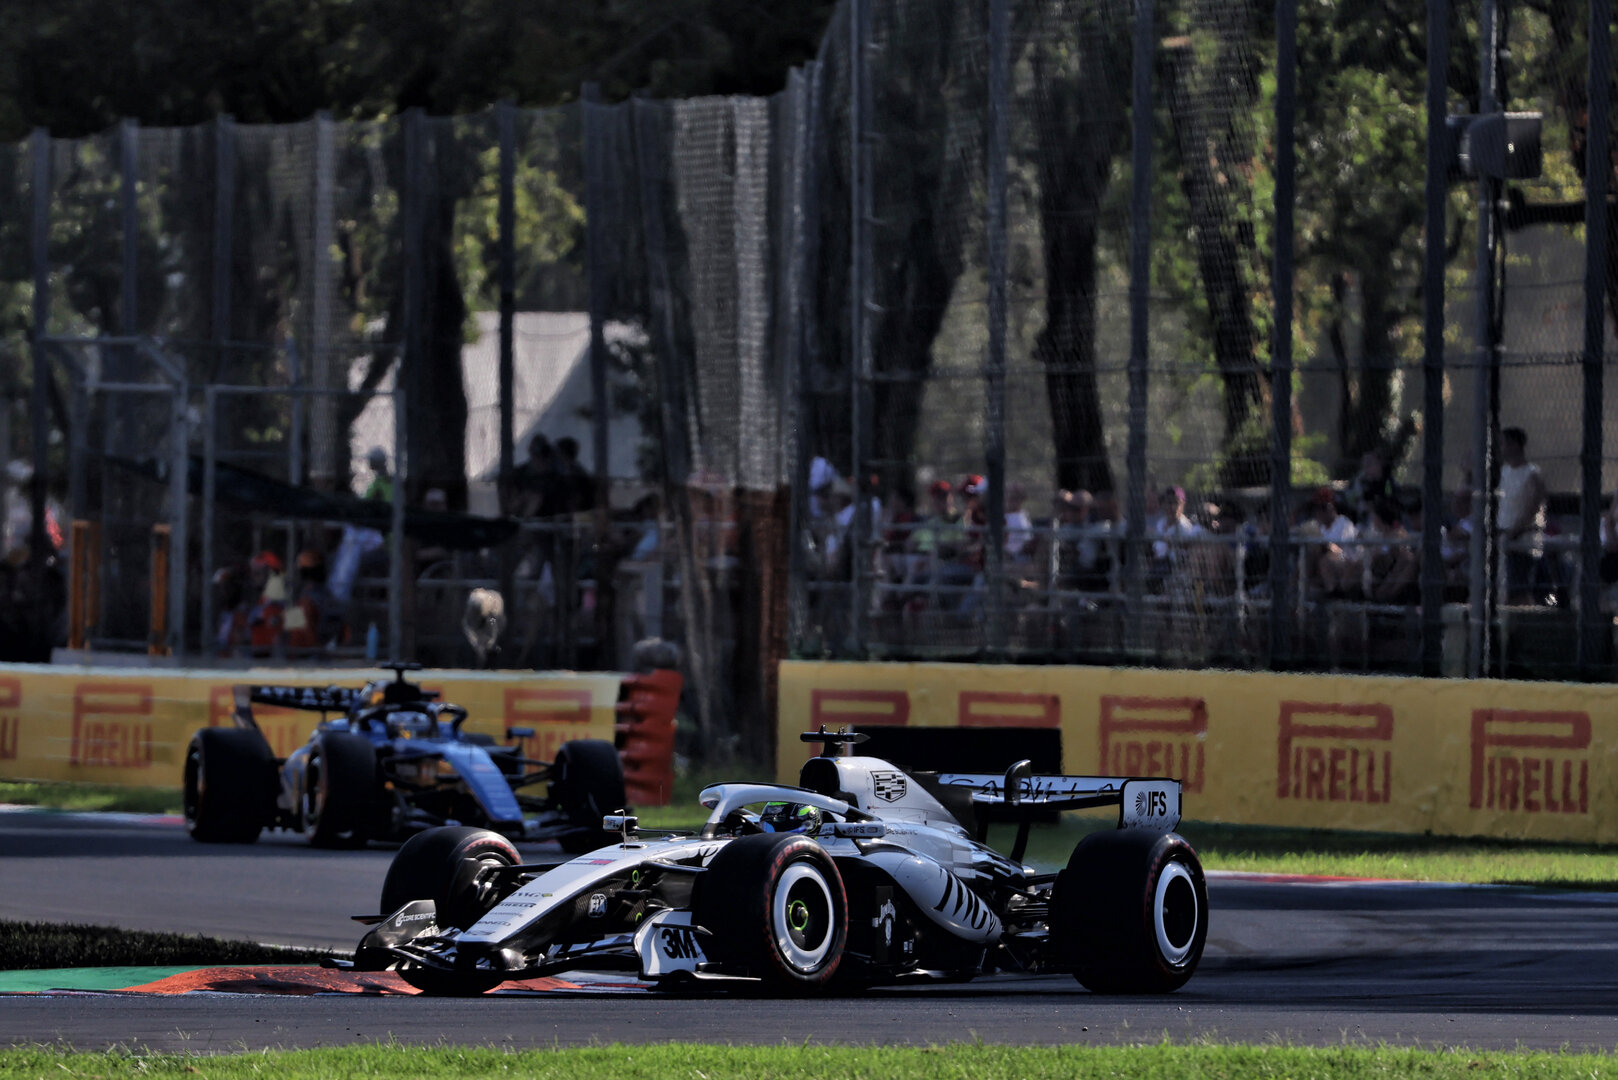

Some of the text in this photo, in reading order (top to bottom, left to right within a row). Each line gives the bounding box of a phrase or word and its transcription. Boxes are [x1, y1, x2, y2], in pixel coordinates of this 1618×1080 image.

[70, 683, 153, 768] PIRELLI
[1276, 700, 1394, 804] PIRELLI
[1469, 707, 1592, 814] PIRELLI
[1148, 791, 1166, 817] IFS
[661, 928, 698, 959] 3M
